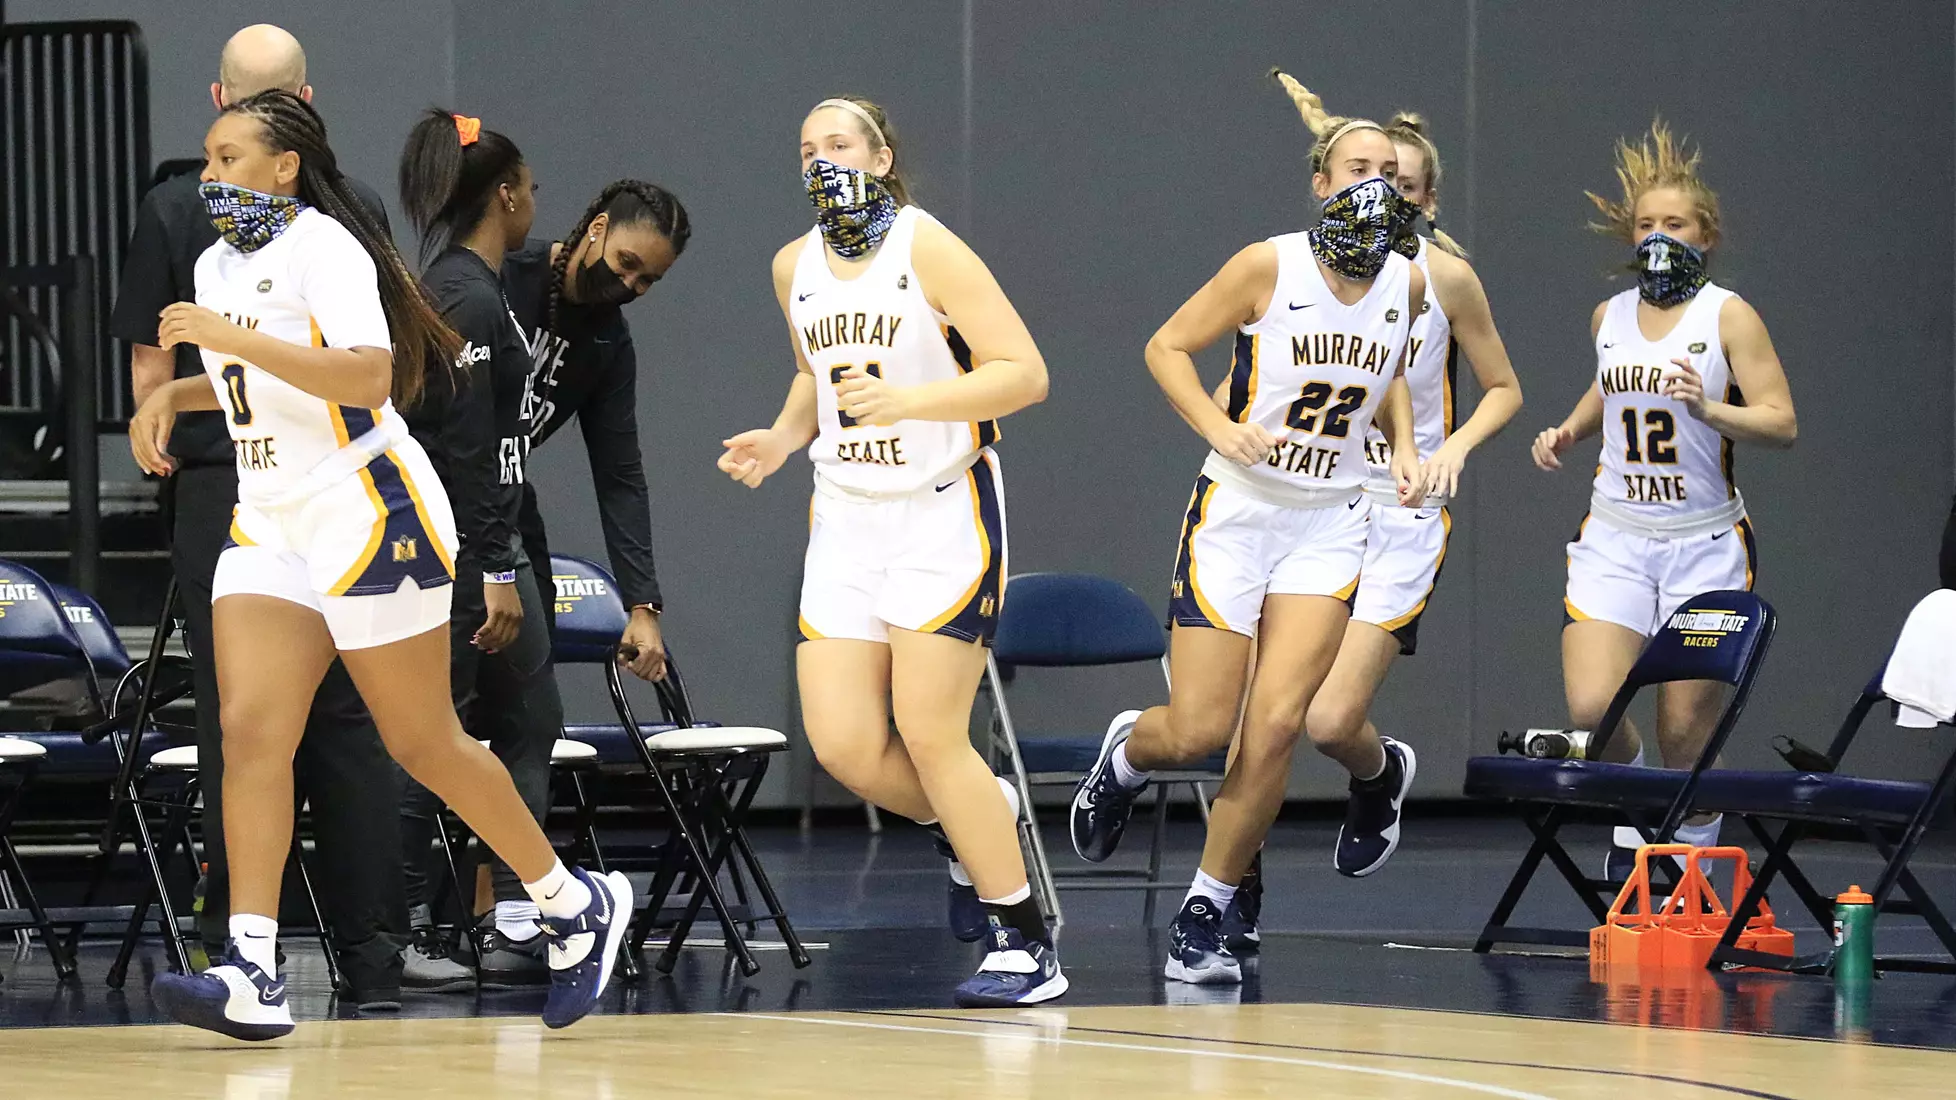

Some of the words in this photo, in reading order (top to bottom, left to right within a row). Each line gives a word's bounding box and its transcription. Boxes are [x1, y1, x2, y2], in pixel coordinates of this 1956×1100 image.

[803, 312, 902, 356] MURRAY
[1291, 333, 1391, 377] MURRAY
[221, 362, 254, 428] 0
[1601, 364, 1677, 397] MURR
[1283, 380, 1369, 440] 22
[837, 437, 907, 467] STATE
[1622, 407, 1679, 465] 12
[233, 437, 278, 471] TATE
[1267, 440, 1341, 479] STATE
[1623, 474, 1687, 502] STATE
[0, 584, 38, 600] TATE
[1667, 613, 1698, 630] MUR
[1719, 615, 1750, 632] TATE
[1683, 636, 1719, 647] RACERS
